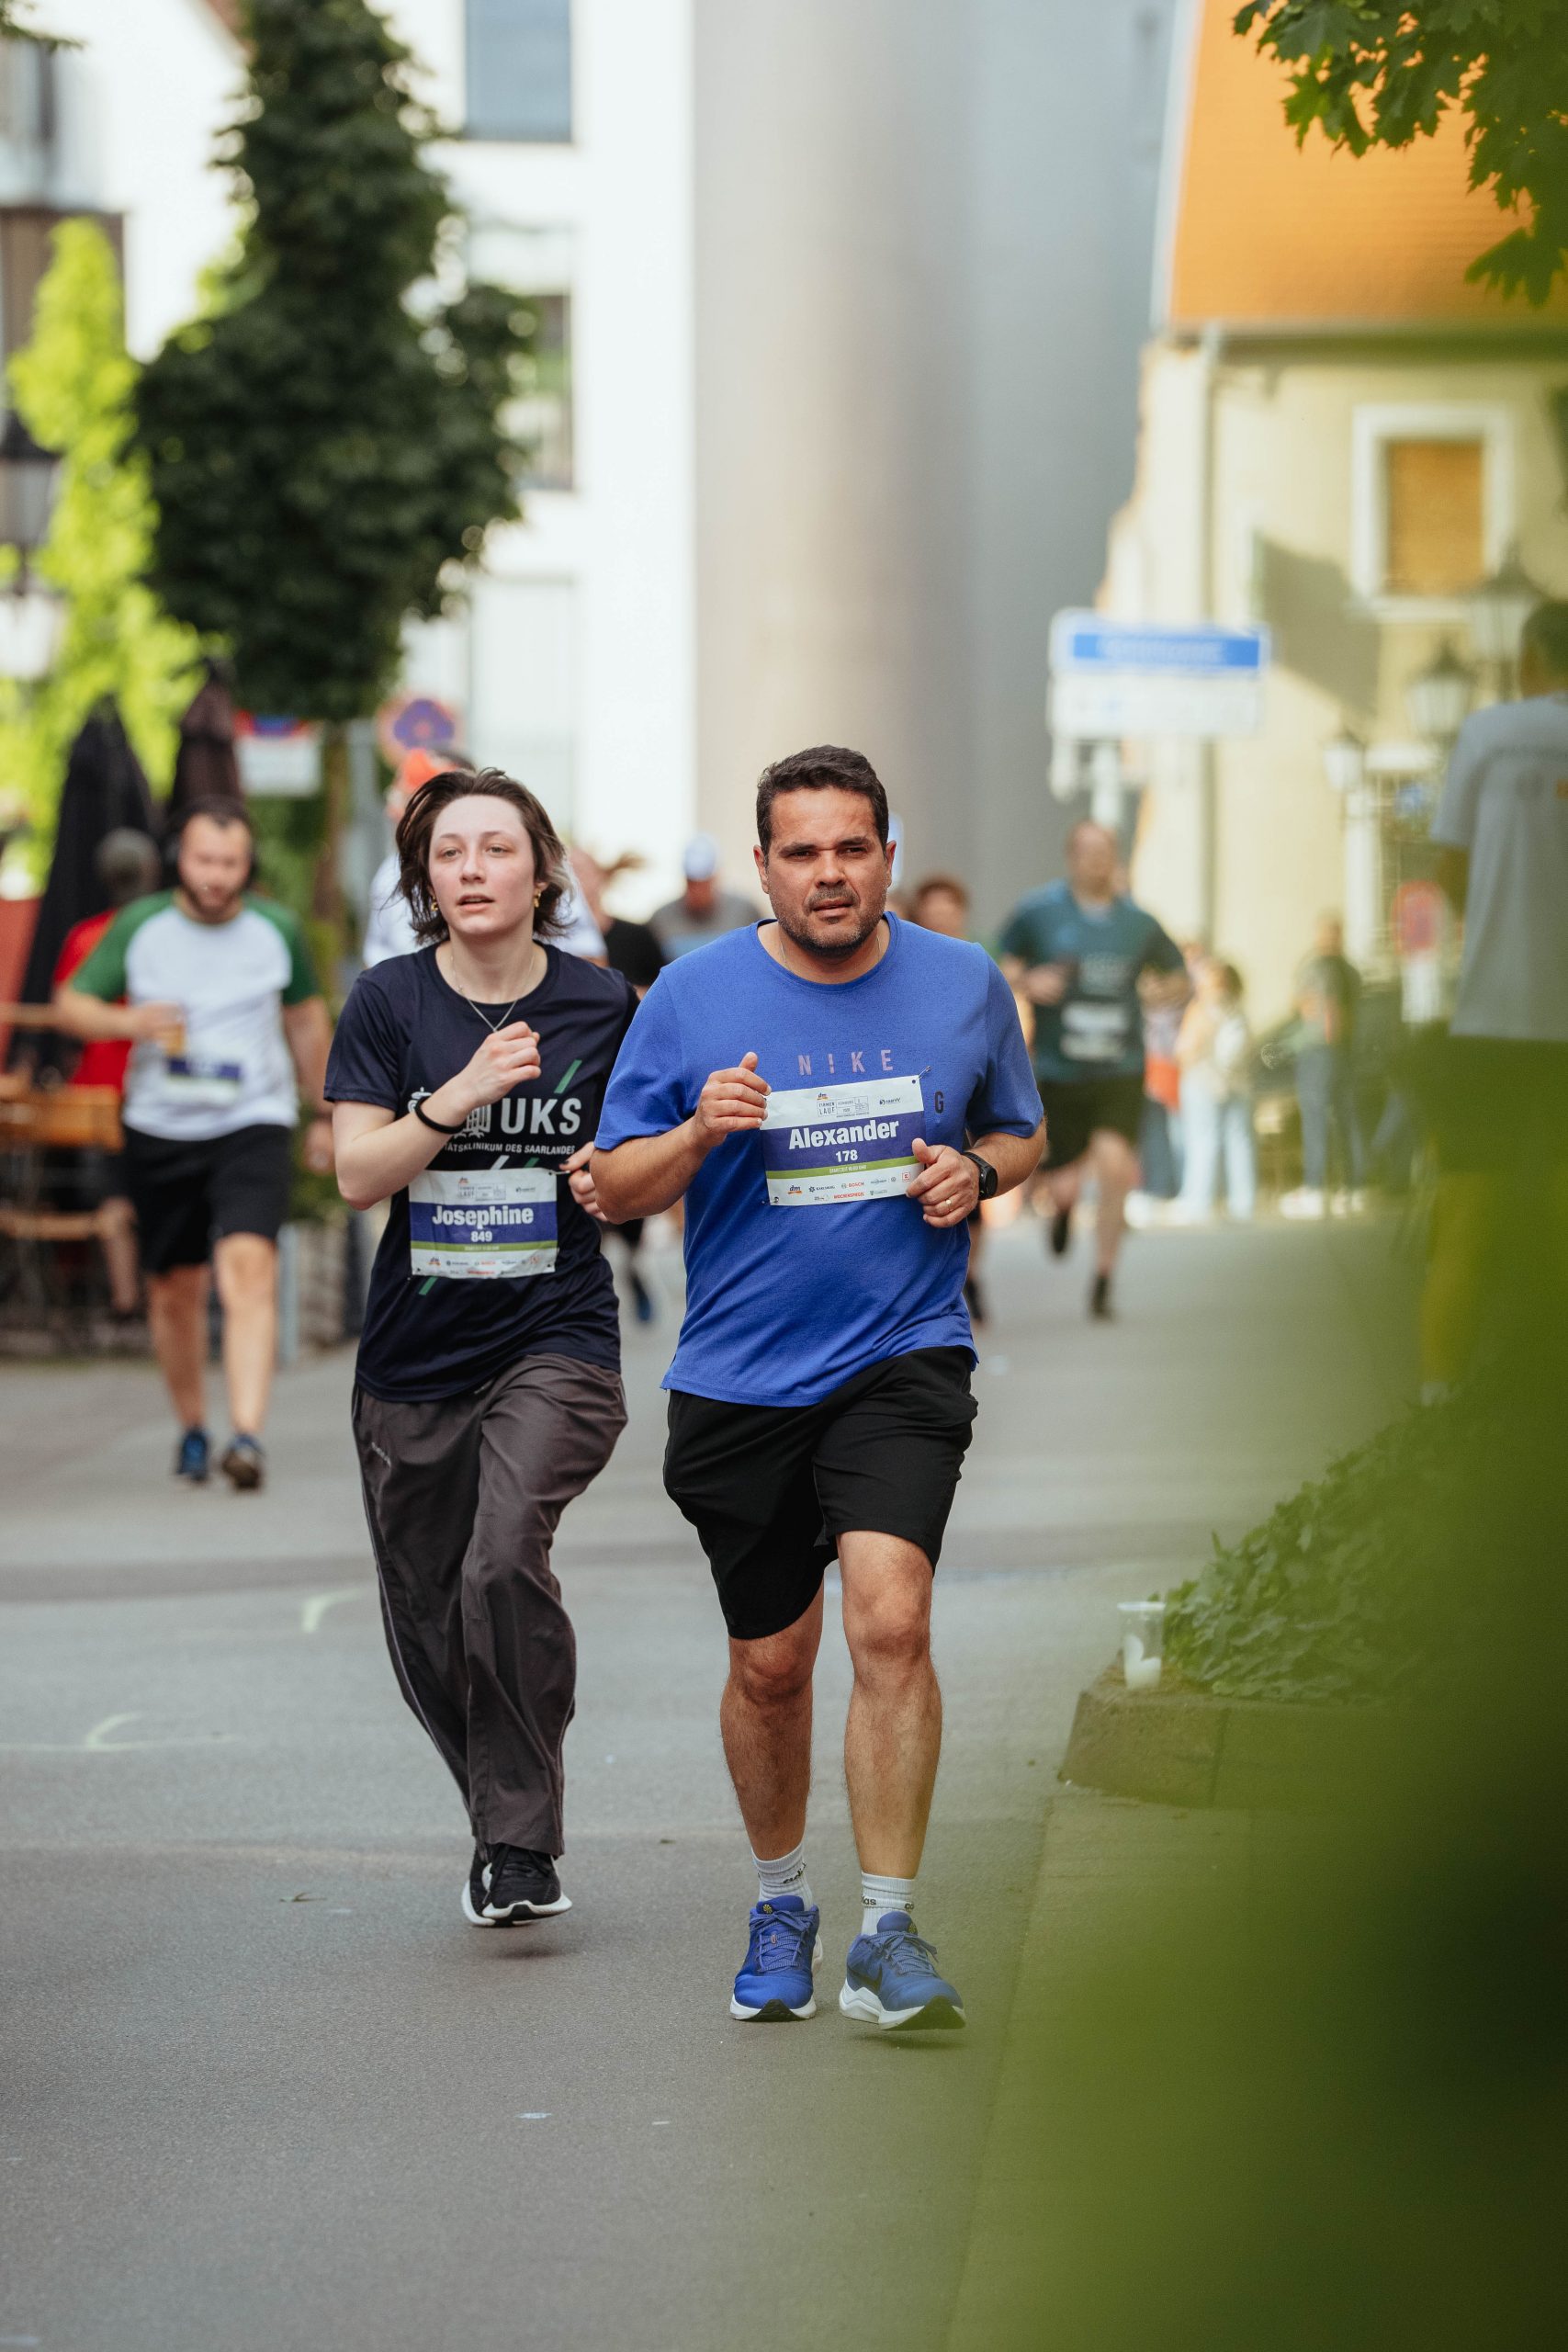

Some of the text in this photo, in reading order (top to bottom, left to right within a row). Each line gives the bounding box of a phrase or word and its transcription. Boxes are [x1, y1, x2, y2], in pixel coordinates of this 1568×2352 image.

[798, 1049, 894, 1076] NIKE
[500, 1097, 582, 1136] UKS
[788, 1119, 899, 1150] Alexander
[505, 1143, 523, 1153] DES
[835, 1149, 859, 1162] 178
[432, 1204, 535, 1229] Josephine
[470, 1230, 493, 1242] 849
